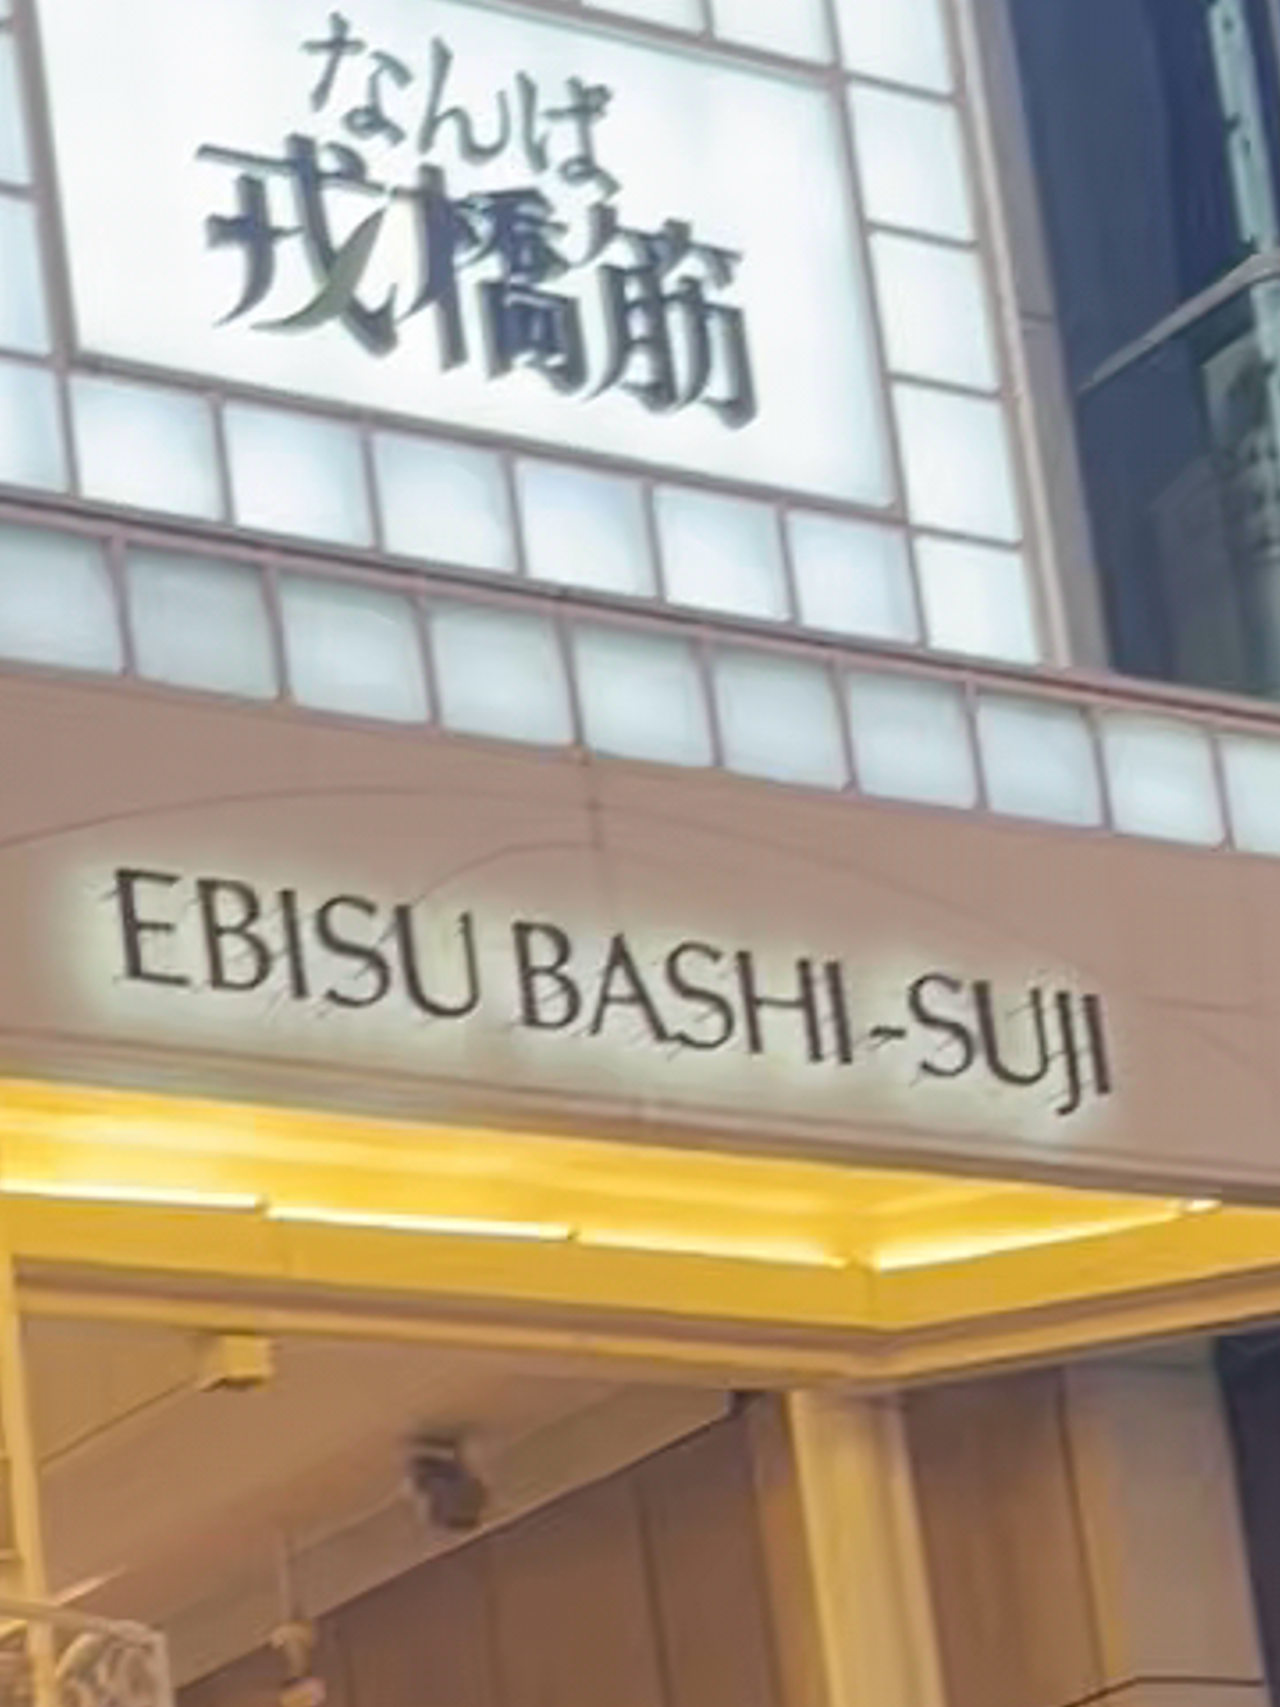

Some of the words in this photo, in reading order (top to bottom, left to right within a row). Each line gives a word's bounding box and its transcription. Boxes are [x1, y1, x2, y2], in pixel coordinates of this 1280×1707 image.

[302, 11, 616, 195] なんば
[195, 131, 761, 429] 戎橋筋
